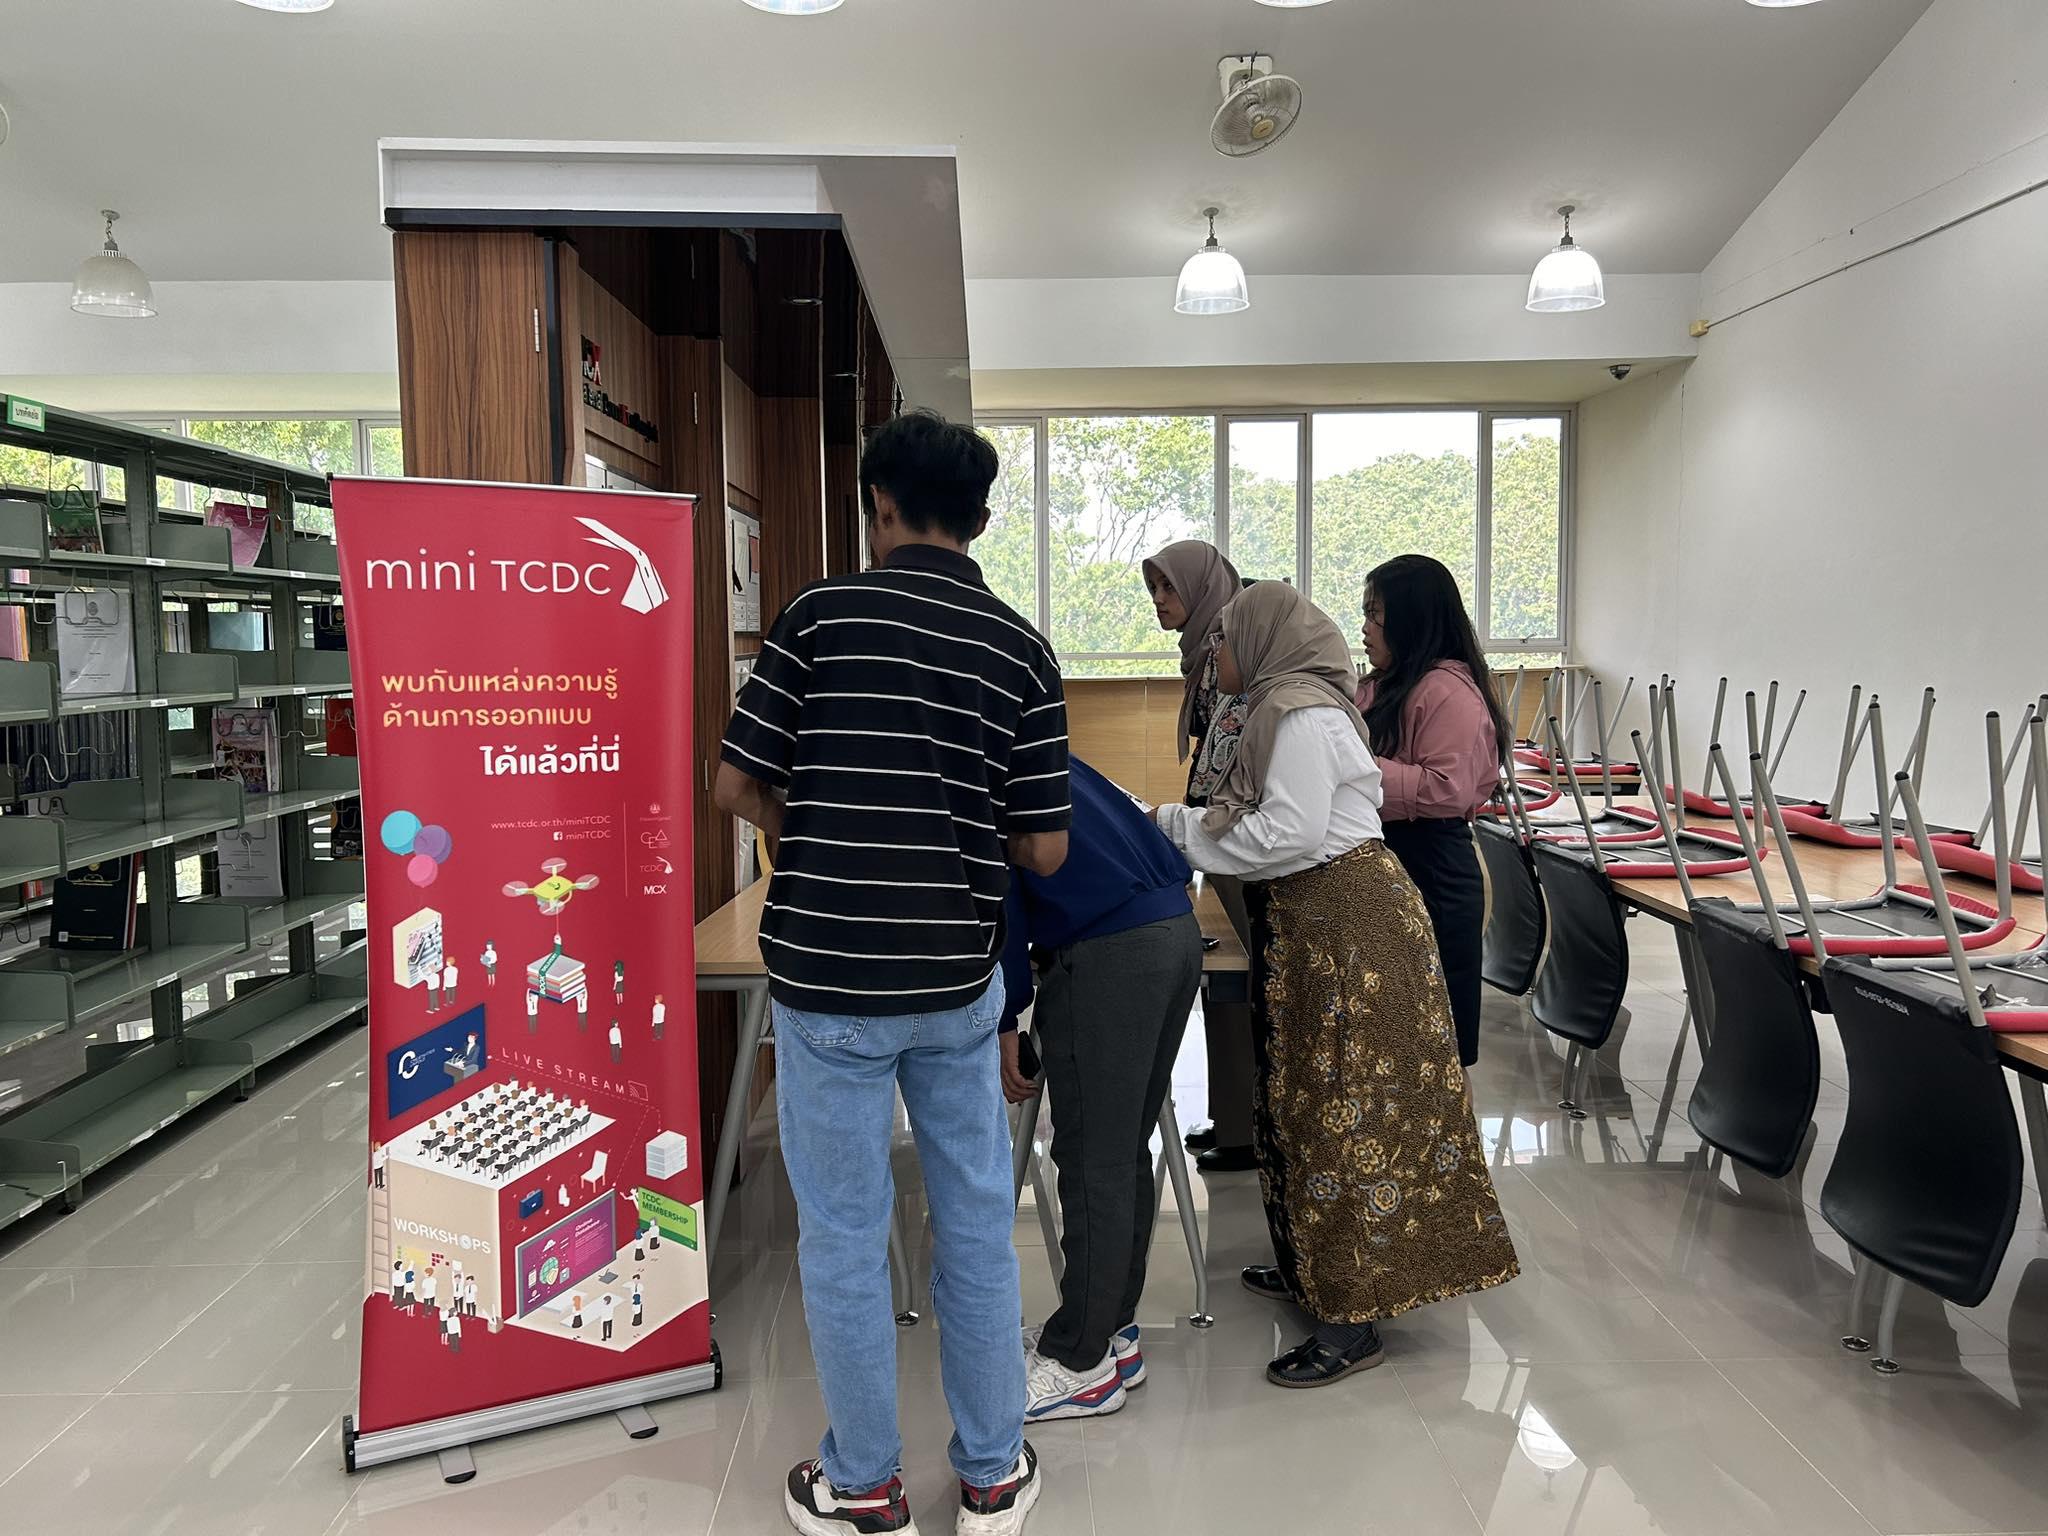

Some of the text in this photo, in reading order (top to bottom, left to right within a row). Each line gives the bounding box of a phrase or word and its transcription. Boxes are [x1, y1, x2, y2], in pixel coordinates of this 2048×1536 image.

[366, 548, 612, 595] mini TCDC
[382, 667, 618, 699] พบกับแหล่งความรู้
[383, 703, 592, 728] ด้านการออกแบบ
[479, 735, 620, 775] ได้แล้วที่นี่
[491, 815, 611, 829] www.tcdc.or.th/miniTCDC
[566, 830, 611, 840] miniTCDC
[640, 865, 663, 873] TCDC
[502, 1047, 624, 1094] LIVE STREAM
[642, 1192, 661, 1206] TCDC
[642, 1201, 689, 1224] MEMBERSHIP
[393, 1217, 491, 1253] WORKSHOPS
